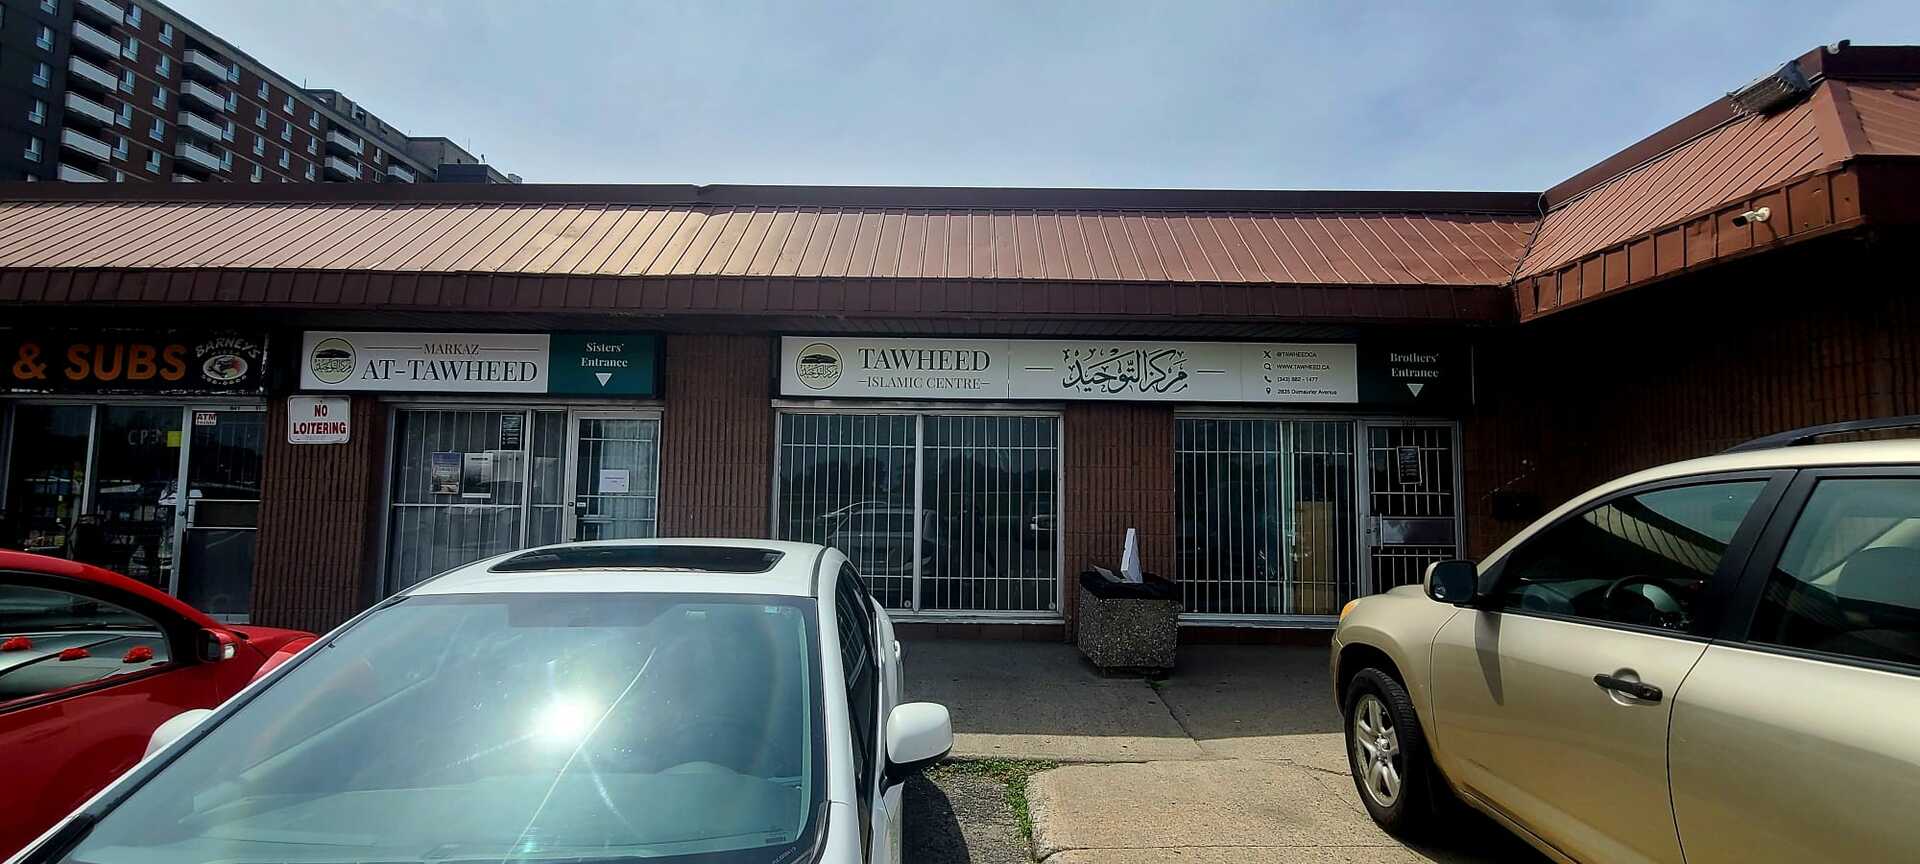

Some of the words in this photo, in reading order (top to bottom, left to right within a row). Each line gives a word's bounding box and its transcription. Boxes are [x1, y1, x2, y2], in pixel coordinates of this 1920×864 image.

[423, 343, 480, 356] MARKAZ
[12, 343, 48, 381] &
[63, 343, 188, 382] SUBS
[580, 356, 628, 368] Entrance
[857, 347, 991, 373] TAWHEED
[360, 357, 539, 384] AT-TAWHEED
[1391, 367, 1440, 378] Entrance
[867, 375, 924, 389] ISLAMIC
[926, 376, 981, 391] CENTRE
[196, 413, 216, 421] ATM
[314, 404, 329, 417] NO
[293, 421, 347, 435] LOITERING
